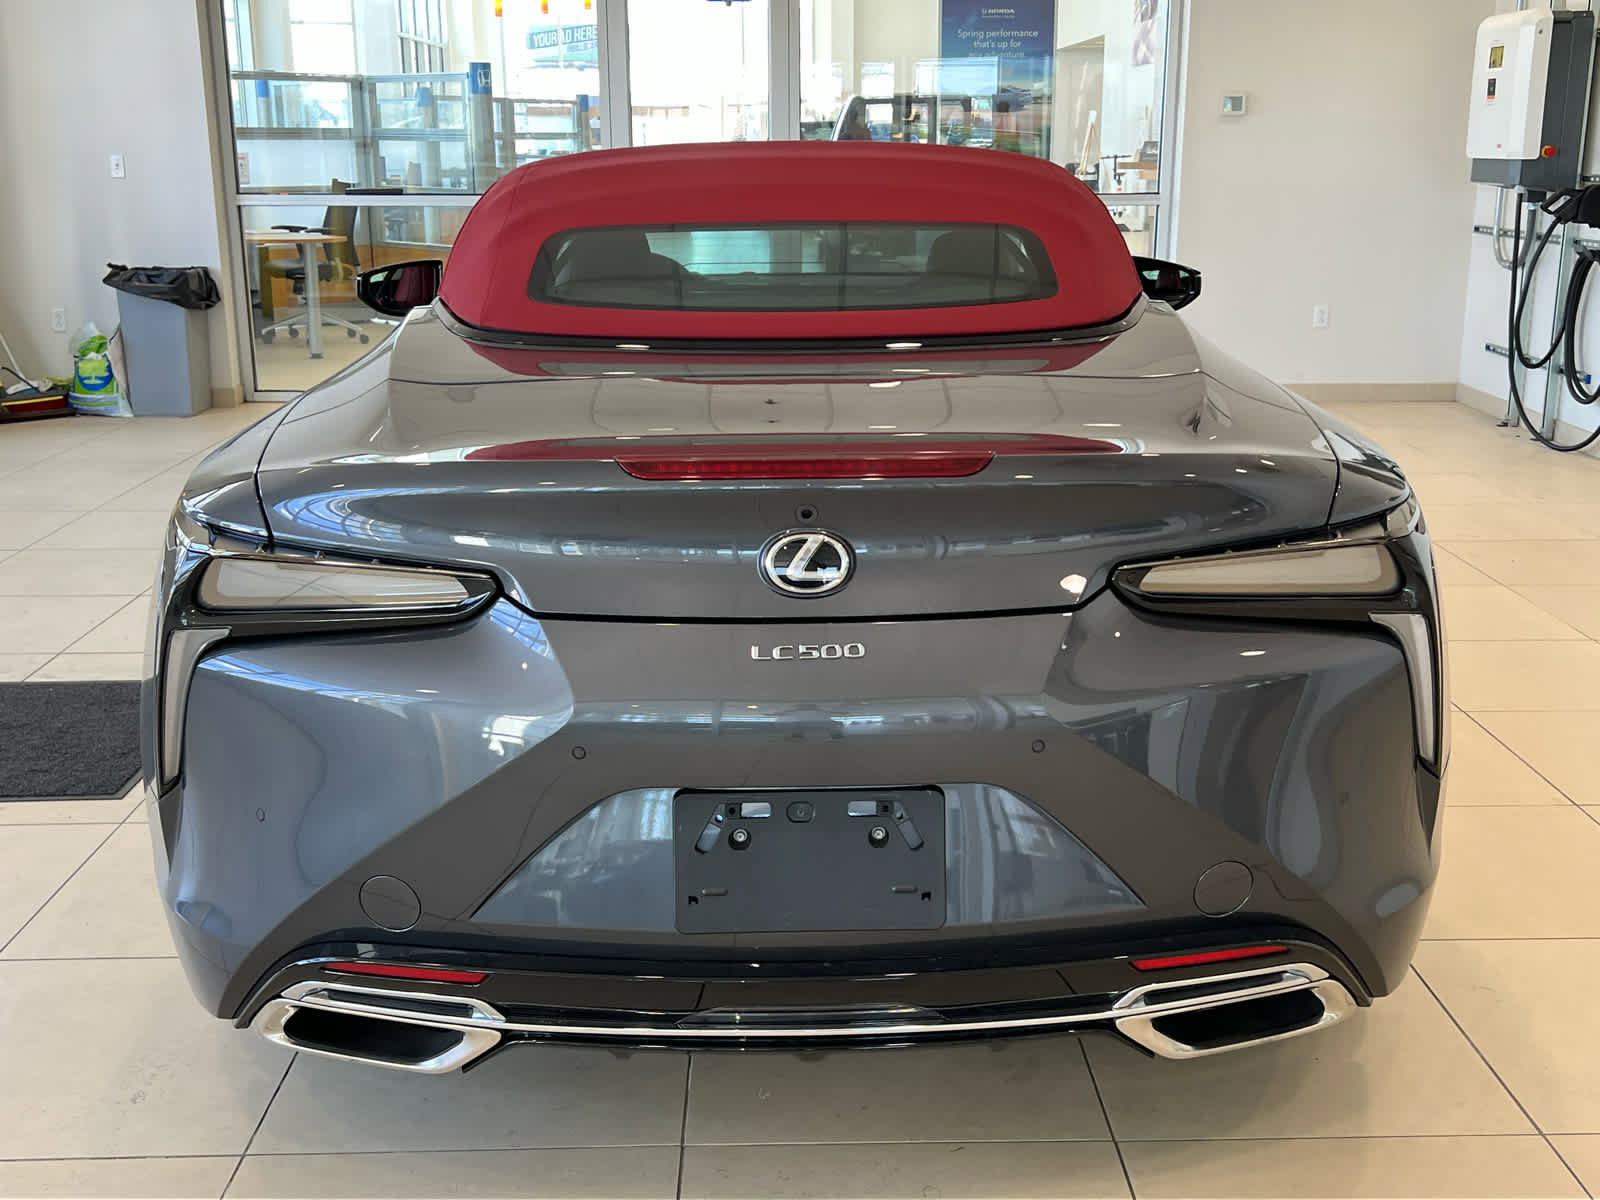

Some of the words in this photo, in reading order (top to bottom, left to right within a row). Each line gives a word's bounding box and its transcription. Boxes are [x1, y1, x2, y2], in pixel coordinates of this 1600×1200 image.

[533, 32, 557, 47] YOUR
[574, 26, 598, 41] HERE
[958, 28, 984, 39] Spring
[986, 28, 1038, 39] performance
[974, 40, 994, 48] that's
[996, 41, 1008, 50] up
[1009, 39, 1022, 48] for
